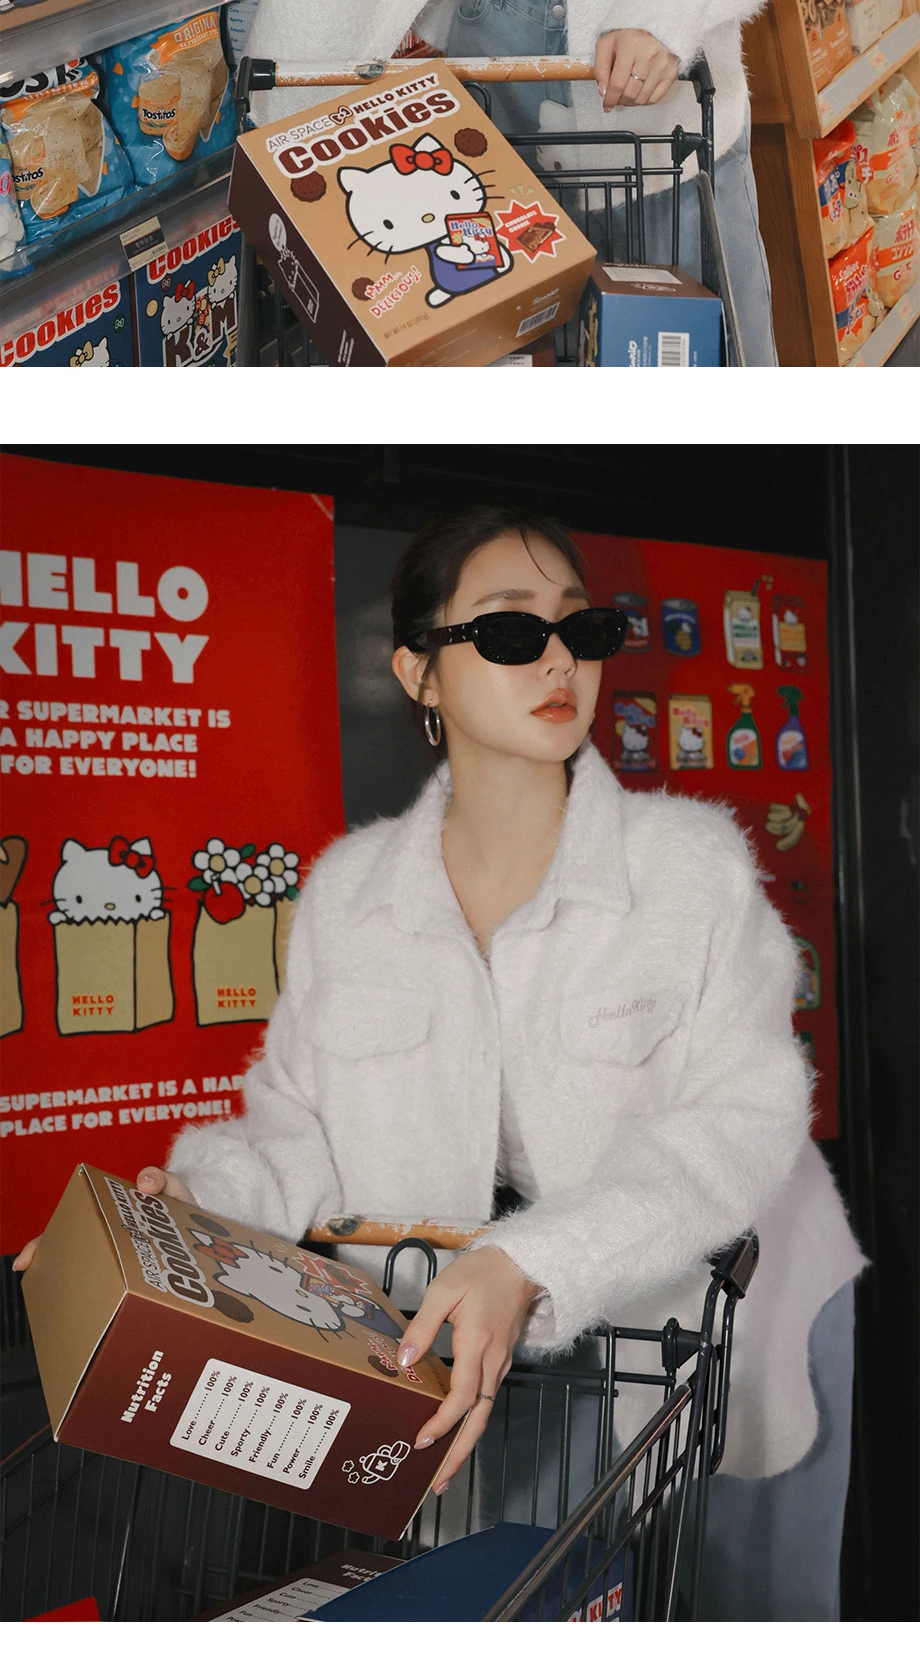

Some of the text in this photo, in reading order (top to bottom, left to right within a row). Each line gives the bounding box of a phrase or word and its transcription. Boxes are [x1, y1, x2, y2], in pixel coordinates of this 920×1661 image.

[268, 75, 437, 151] AIR SPACE HELLO KITTY
[278, 92, 456, 174] Cookies
[371, 266, 422, 318] DELICIOUS!
[0, 621, 210, 684] KITTY
[17, 700, 231, 729] SUPERMARKET IS
[26, 728, 198, 753] HAPPY PLACE
[0, 754, 198, 779] FOR EVERYONE!
[72, 994, 114, 1005] HELLO
[72, 1006, 114, 1017] KITTY
[120, 1350, 165, 1424] Nutrition
[144, 1371, 173, 1413] Facts
[182, 1369, 221, 1441] Love 100%
[198, 1374, 238, 1447] Cheer 100%
[214, 1430, 231, 1452] Cute
[230, 1385, 271, 1458] Sporty 100%
[248, 1428, 272, 1464] Friendly
[282, 1402, 324, 1475] Power 100%
[298, 1408, 340, 1480] Smile 100%
[267, 1452, 281, 1470] Fun
